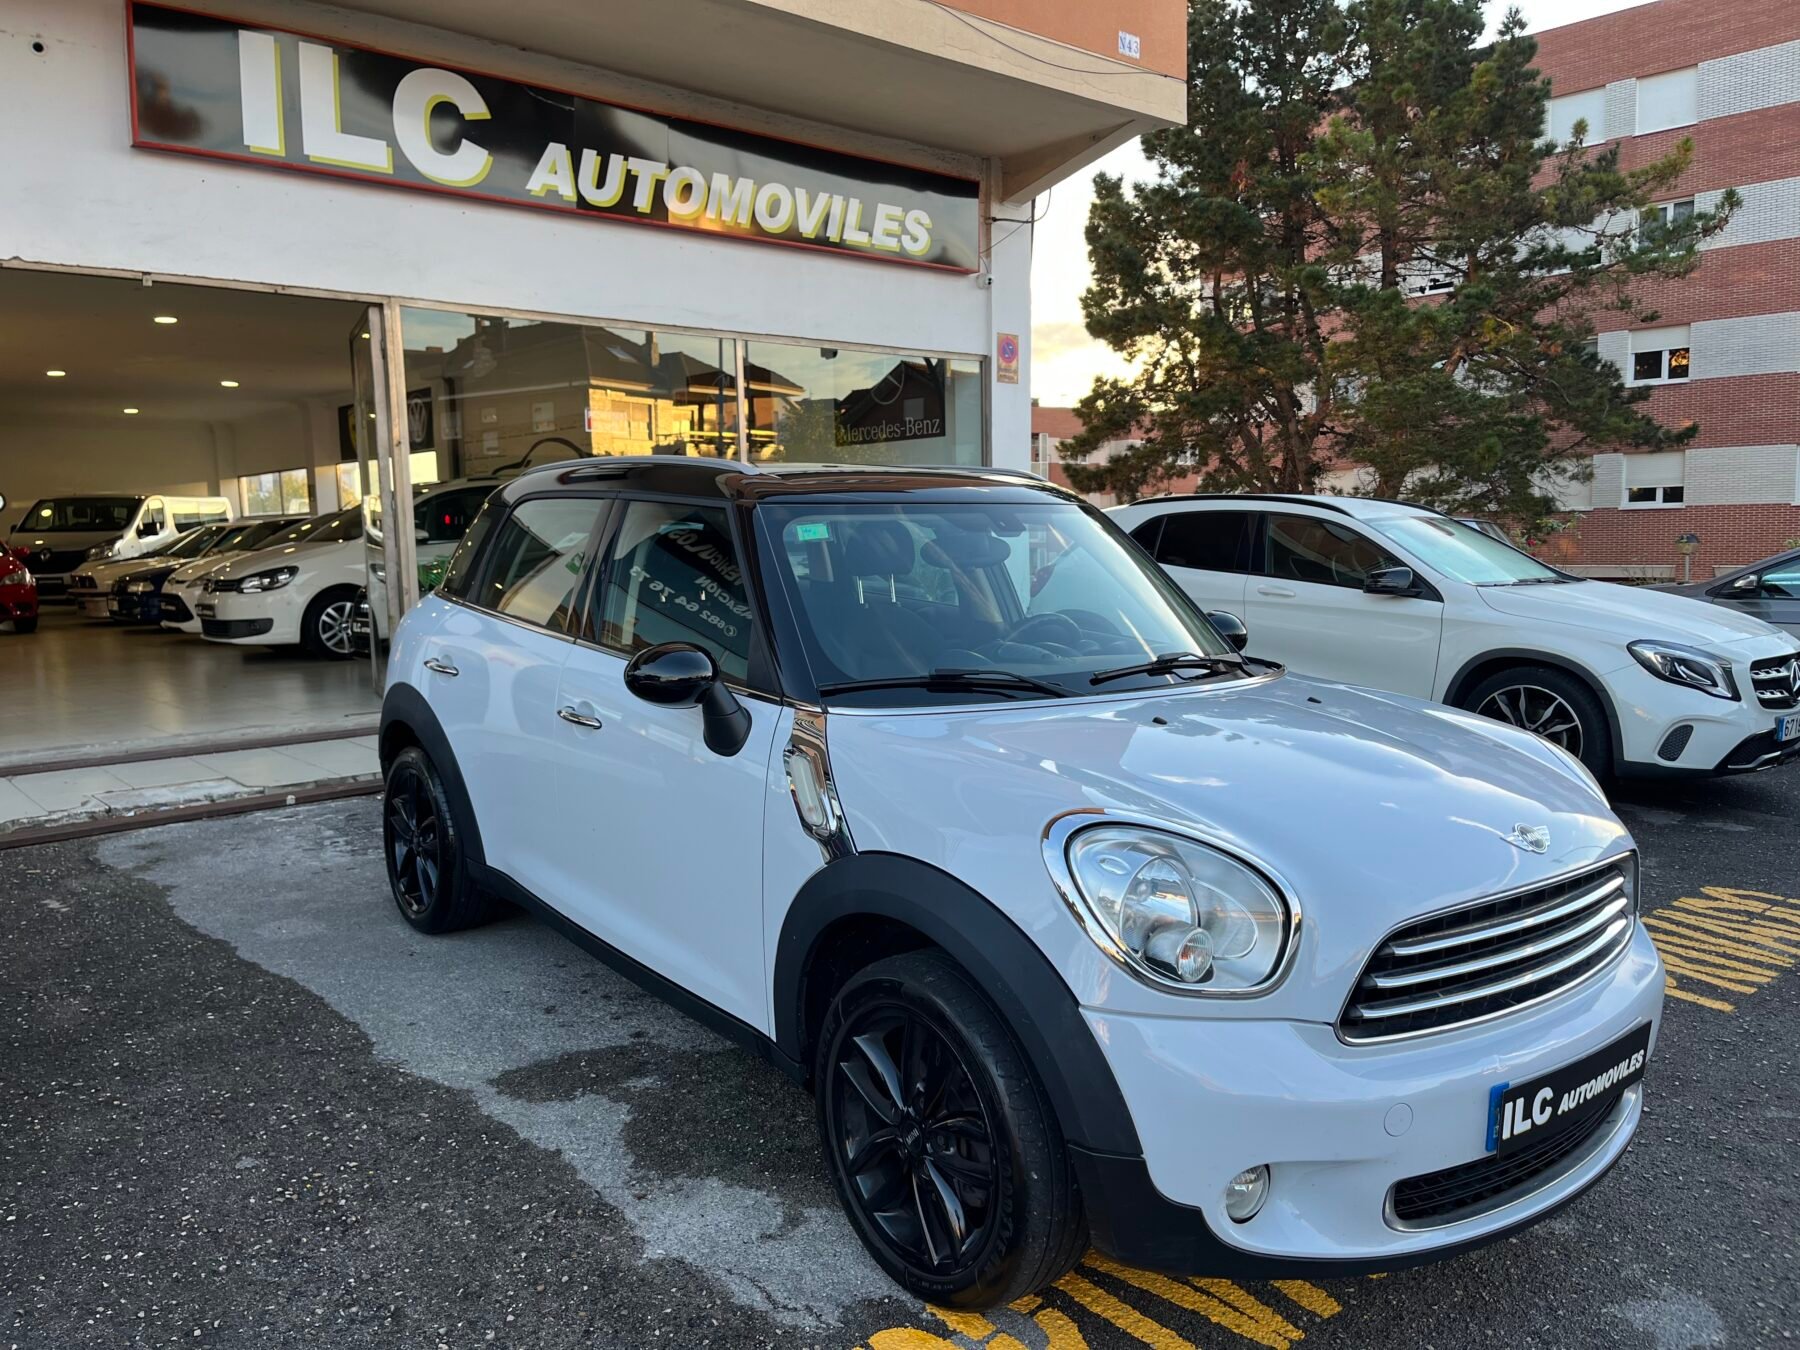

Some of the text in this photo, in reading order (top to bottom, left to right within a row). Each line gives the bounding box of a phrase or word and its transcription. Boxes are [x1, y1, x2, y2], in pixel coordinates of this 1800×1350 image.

[238, 29, 932, 255] ILC AUTOMOVILES
[839, 417, 941, 442] Mercedes-Benz
[1502, 1049, 1645, 1140] ILC AUTOMOVILES
